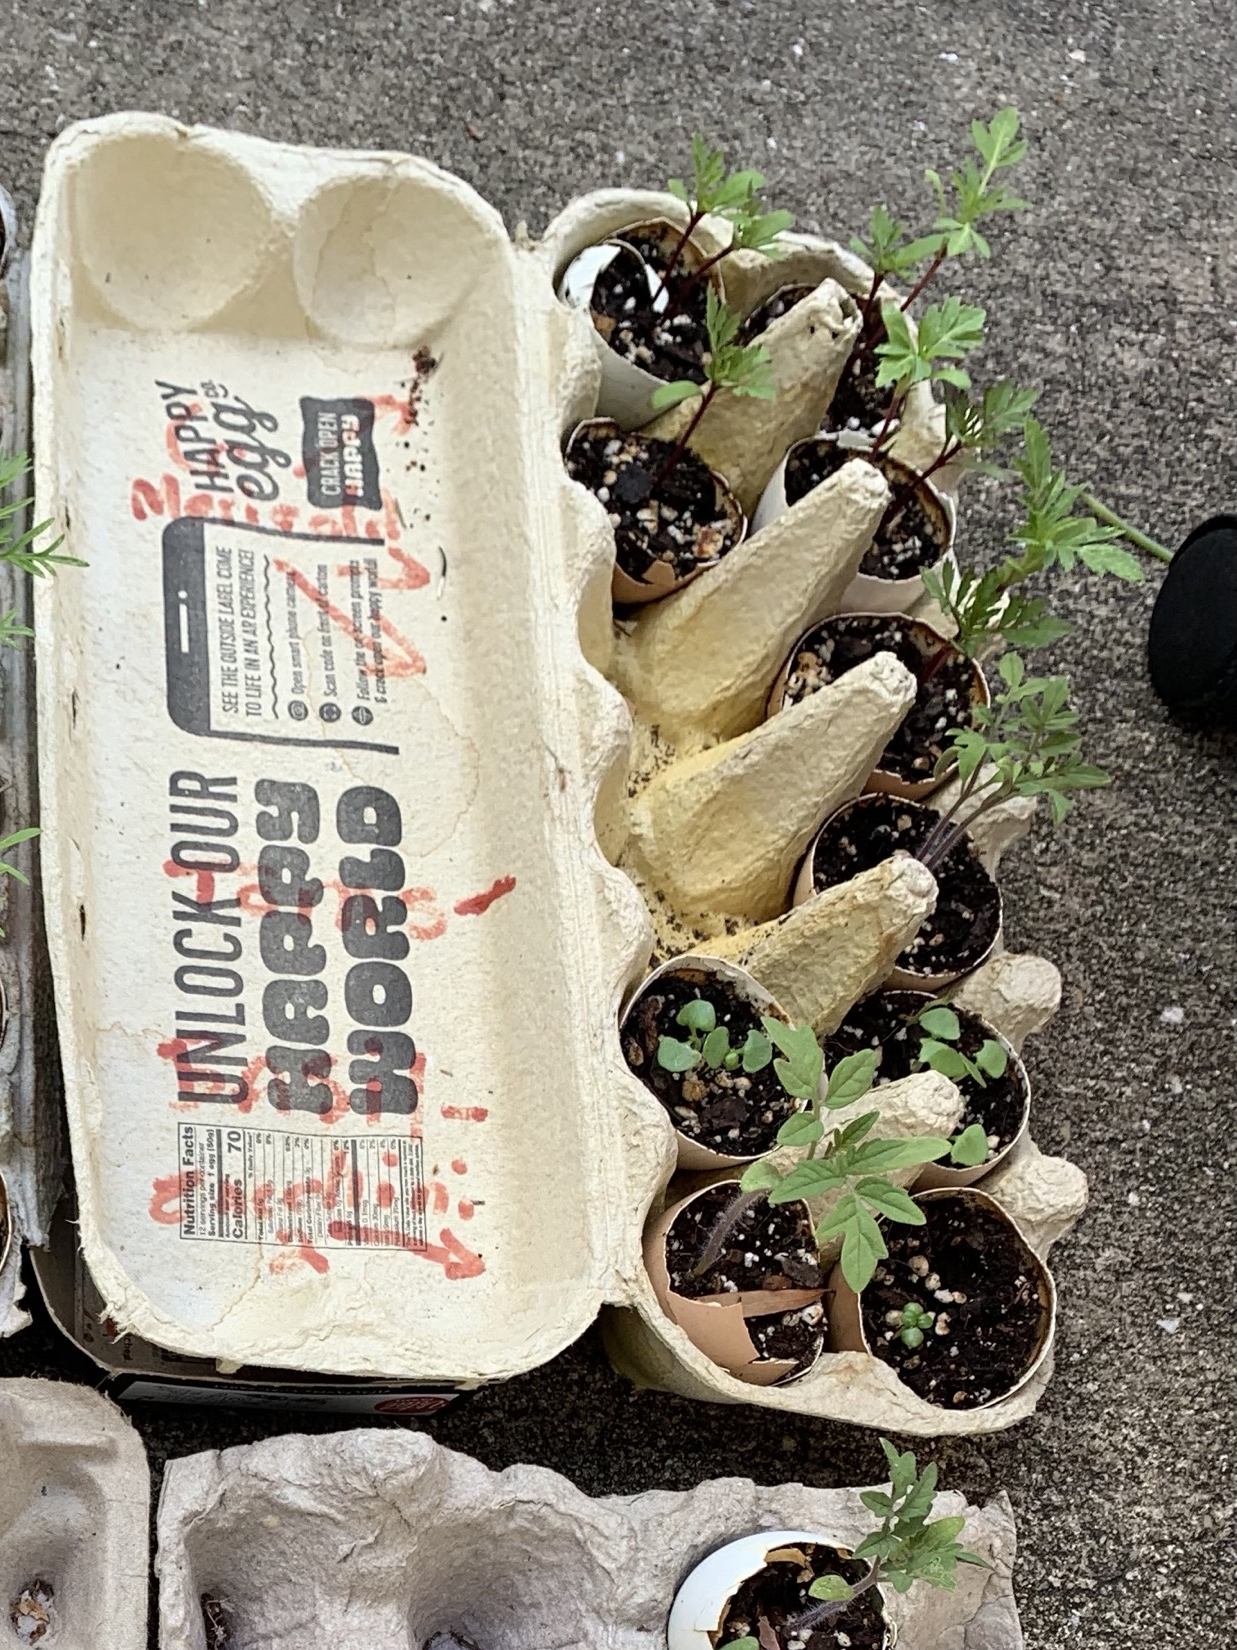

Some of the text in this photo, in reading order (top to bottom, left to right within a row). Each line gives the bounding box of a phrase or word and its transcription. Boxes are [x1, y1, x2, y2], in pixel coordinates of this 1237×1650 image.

[154, 380, 233, 493] HAPPY
[210, 396, 291, 500] egg
[318, 412, 341, 495] CRACK OPEN
[340, 414, 364, 497] HAPPY
[317, 564, 328, 596] carton
[350, 560, 363, 599] prompts
[368, 591, 382, 620] happy
[216, 546, 238, 713] SEE THE OUTSIDE LABEL COME
[238, 549, 262, 716] TO LIFE IN AN AR EXPERIENCE!
[286, 611, 303, 639] phone
[317, 611, 329, 633] front
[370, 623, 381, 639] our
[289, 642, 302, 668] smart
[321, 636, 331, 647] on
[372, 642, 388, 665] open
[320, 650, 334, 671] code
[354, 652, 367, 666] the
[292, 671, 306, 694] Open
[324, 674, 337, 697] Scan
[356, 669, 370, 700] Follow
[371, 668, 386, 694] crack
[169, 771, 248, 1104] UNLOCK OUR
[254, 778, 333, 1114] HAPPY
[336, 785, 418, 1115] WORLD
[206, 1129, 214, 1151] (50g)
[182, 1127, 195, 1235] Nutrition Facts
[227, 1131, 243, 1239] Calories 70
[198, 1193, 207, 1225] servings
[208, 1203, 216, 1236] Serving
[199, 1226, 206, 1235] 12
